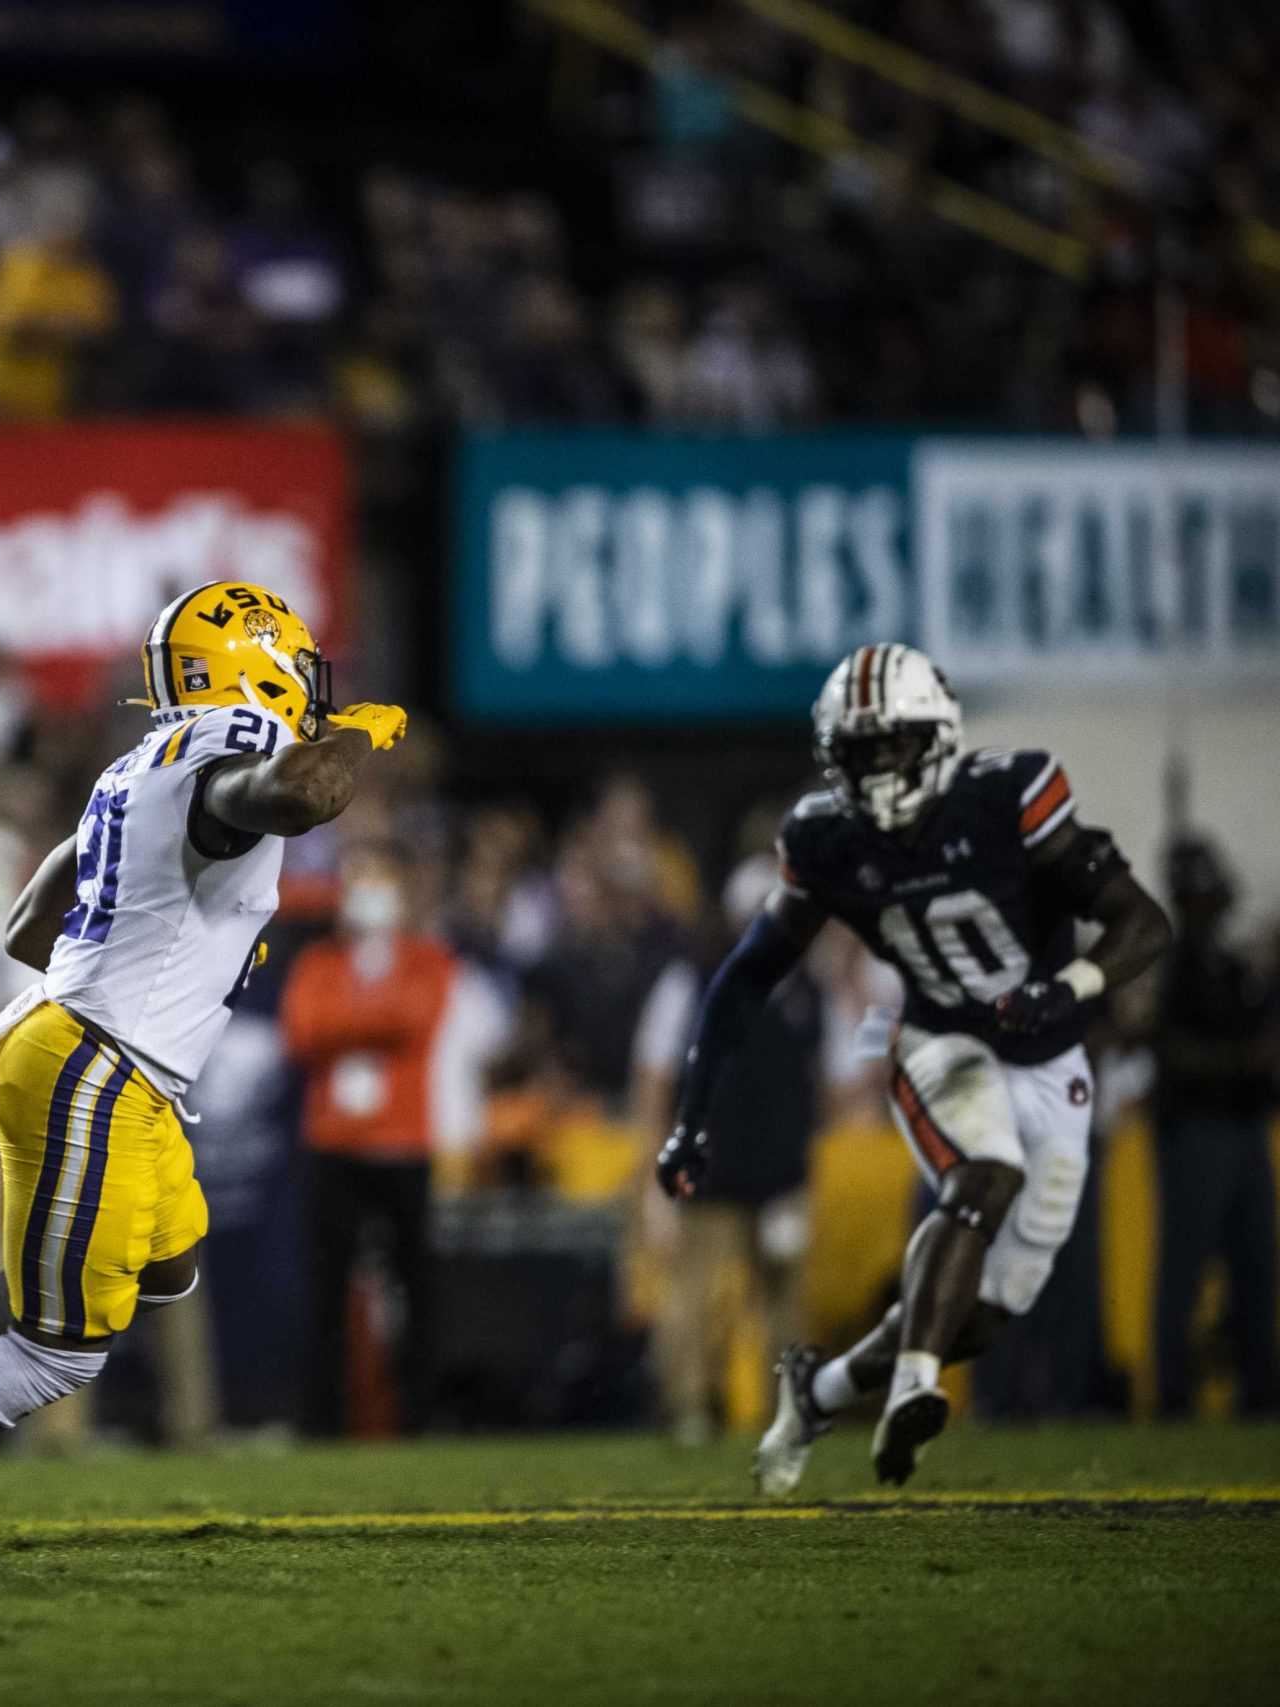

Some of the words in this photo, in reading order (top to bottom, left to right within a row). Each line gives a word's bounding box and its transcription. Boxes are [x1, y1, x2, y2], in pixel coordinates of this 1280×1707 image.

[489, 487, 906, 668] PEOPLES
[225, 708, 279, 757] 21
[63, 788, 129, 944] 21
[879, 888, 1032, 1009] 10
